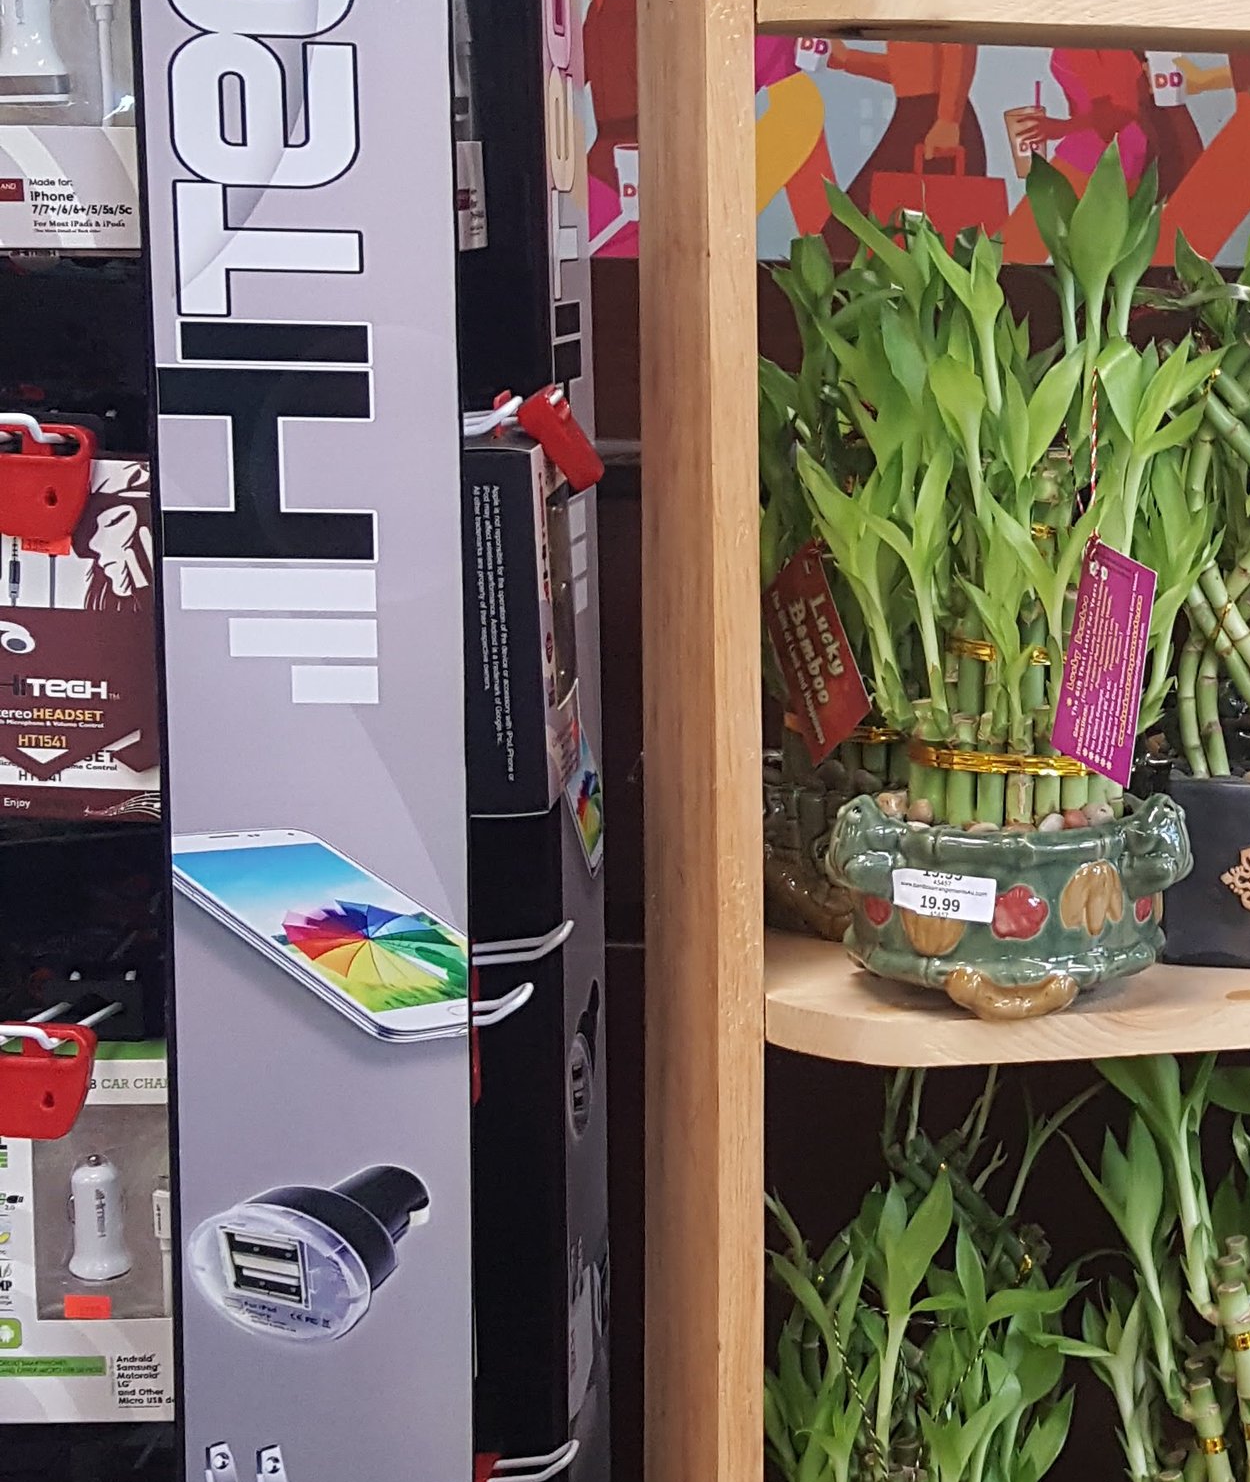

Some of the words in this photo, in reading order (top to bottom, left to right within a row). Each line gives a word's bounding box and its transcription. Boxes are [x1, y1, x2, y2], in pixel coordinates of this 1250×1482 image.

[810, 593, 844, 677] Lucky
[789, 598, 829, 704] Bamboo
[33, 707, 103, 722] HEADSET
[18, 734, 66, 748] HT1541
[4, 797, 31, 809] Enjoy
[920, 894, 960, 912] 19.99
[101, 1079, 129, 1090] CAR
[116, 1363, 161, 1373] Samsung
[139, 1388, 164, 1396] Other
[118, 1397, 144, 1405] Micro
[147, 1397, 163, 1405] USB
